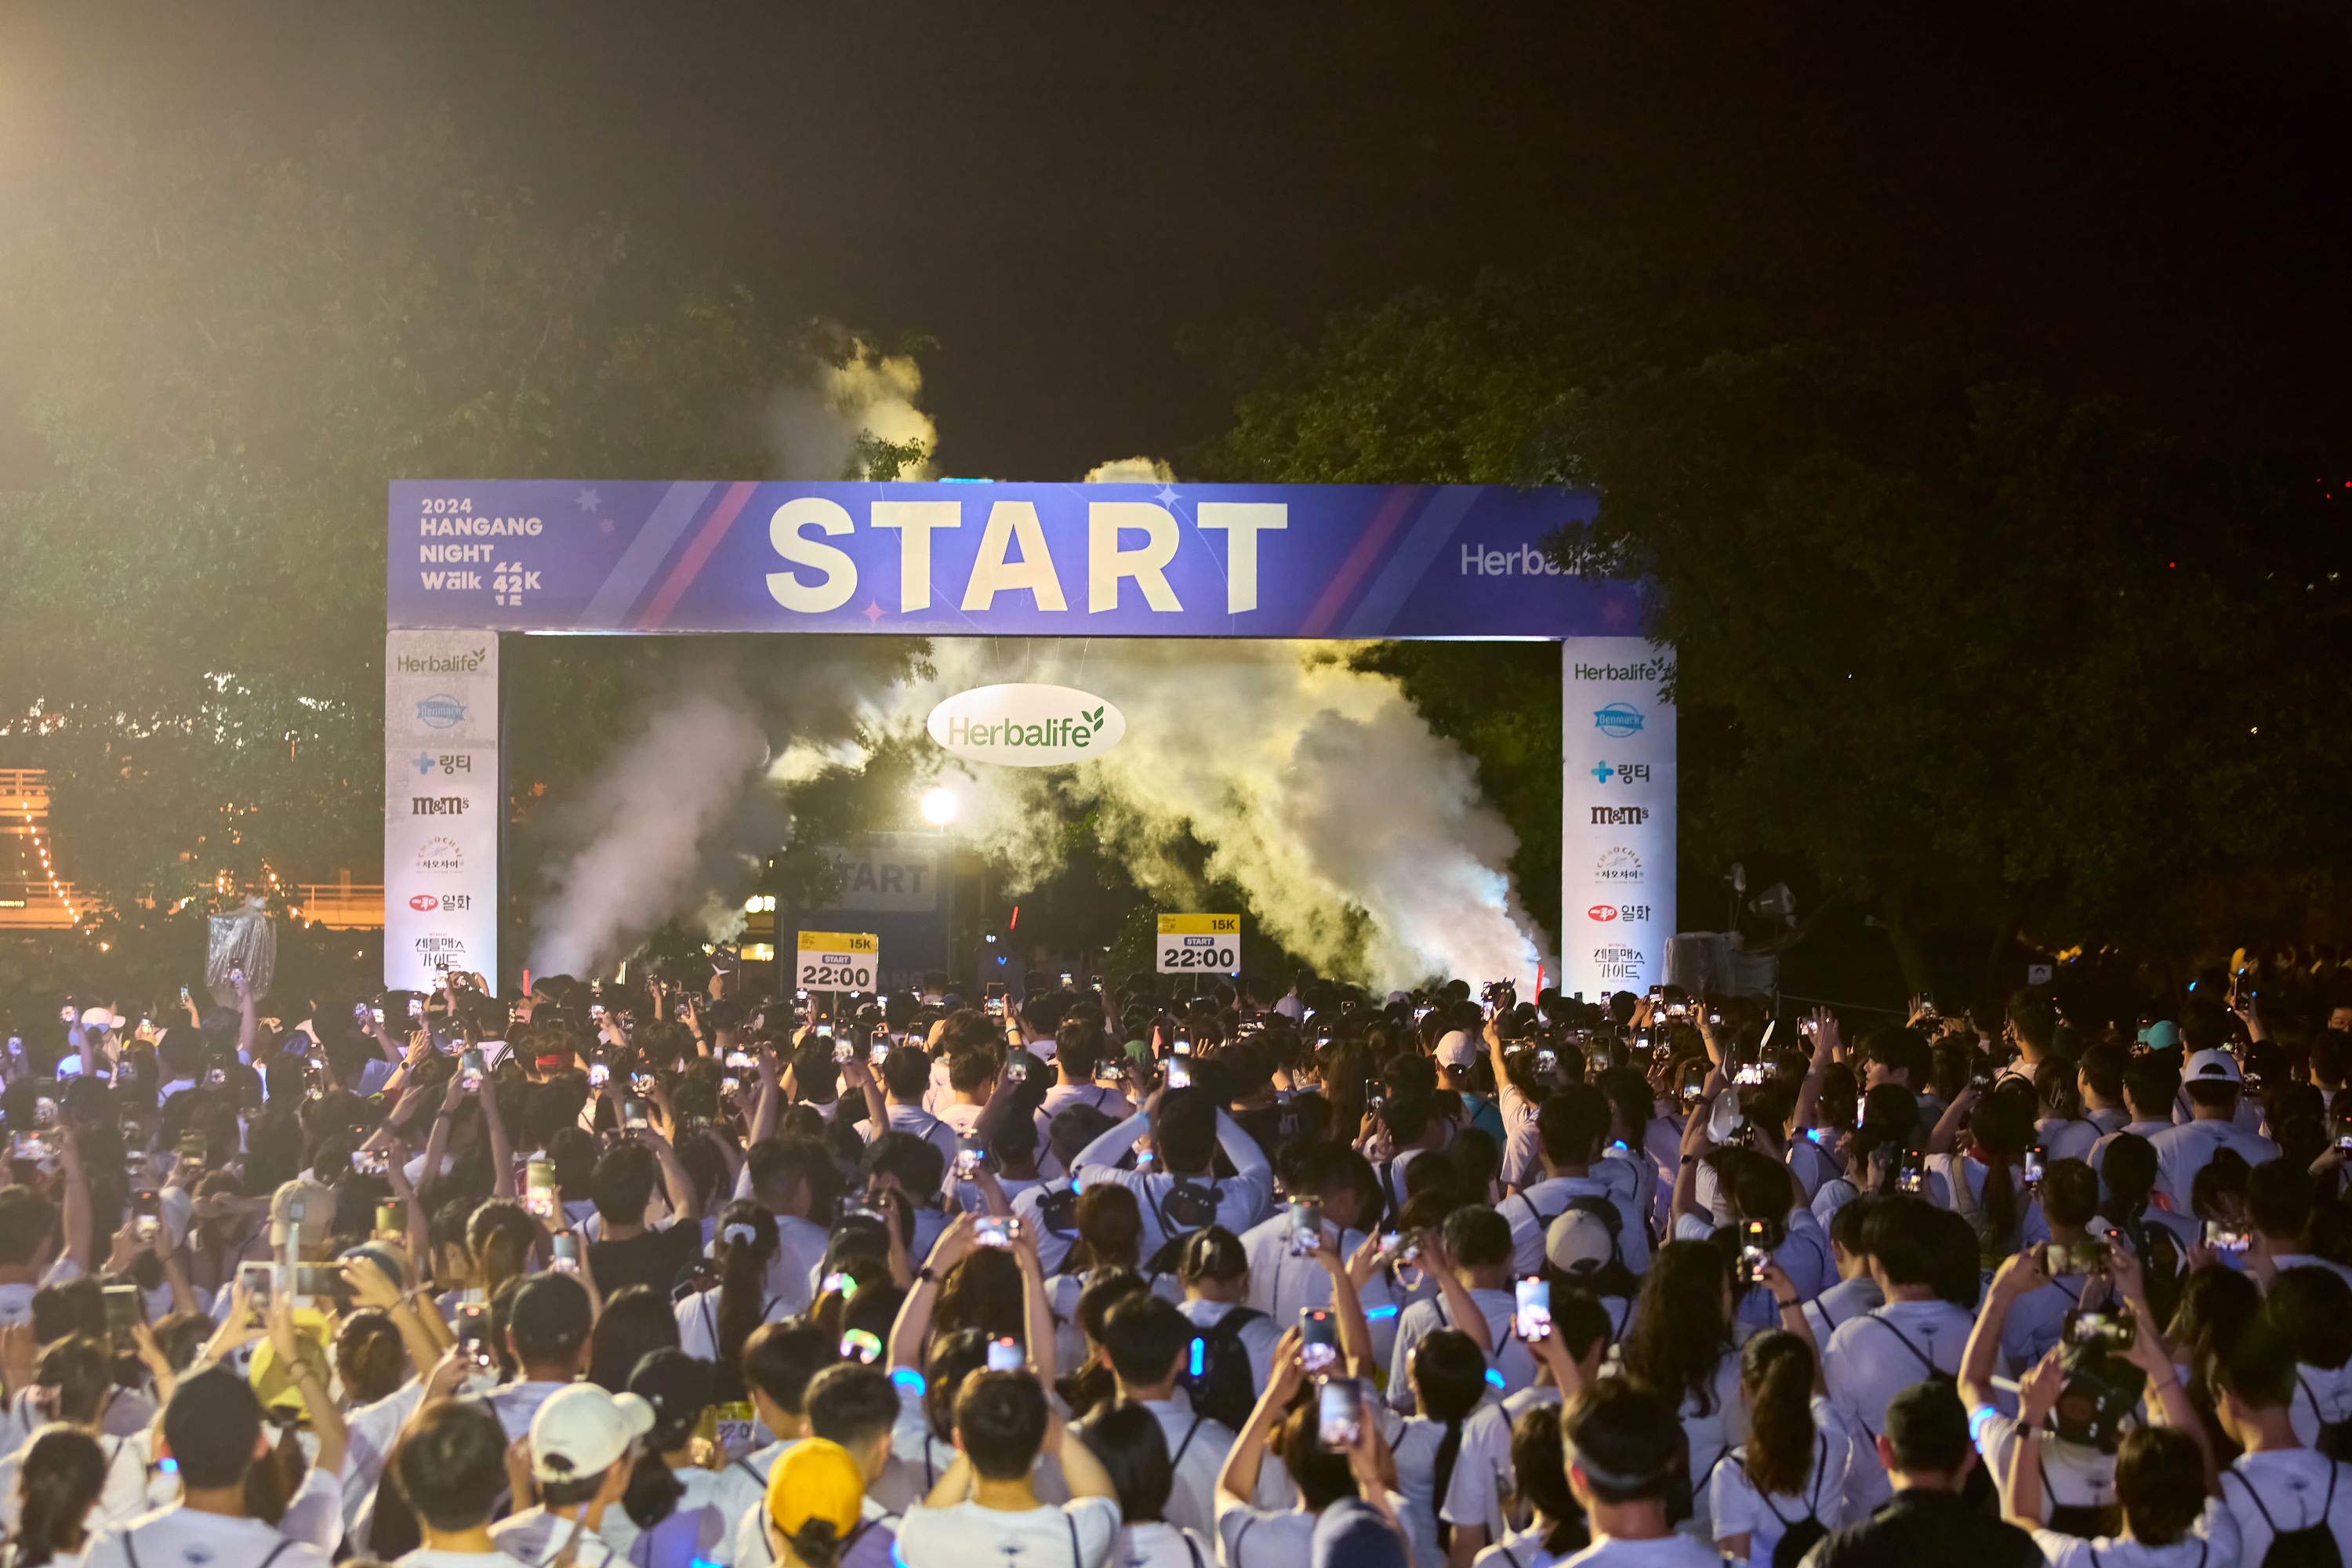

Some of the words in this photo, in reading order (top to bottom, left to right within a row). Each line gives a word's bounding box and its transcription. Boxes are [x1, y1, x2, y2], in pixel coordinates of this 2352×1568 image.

[421, 499, 472, 514] 2024
[420, 517, 543, 536] HANGANG
[420, 544, 494, 563] NIGHT
[766, 497, 1287, 615] START
[398, 655, 478, 672] Herbalife
[1575, 663, 1657, 681] Herbalife
[421, 704, 461, 716] Denmark
[1599, 713, 1640, 726] Denmark
[949, 717, 1091, 748] Herbalife
[439, 754, 471, 775] 링티
[1617, 764, 1650, 784] 링티
[442, 895, 471, 911] 일화
[1621, 905, 1651, 922] 일화
[1211, 919, 1235, 930] 15K
[849, 938, 871, 949] 15K
[420, 953, 461, 967] 가이드
[824, 955, 848, 964] START
[1164, 948, 1235, 967] 22:00
[1594, 948, 1645, 964] 젠틀맨스
[802, 965, 870, 987] 22:00
[1598, 964, 1640, 979] 가이드
